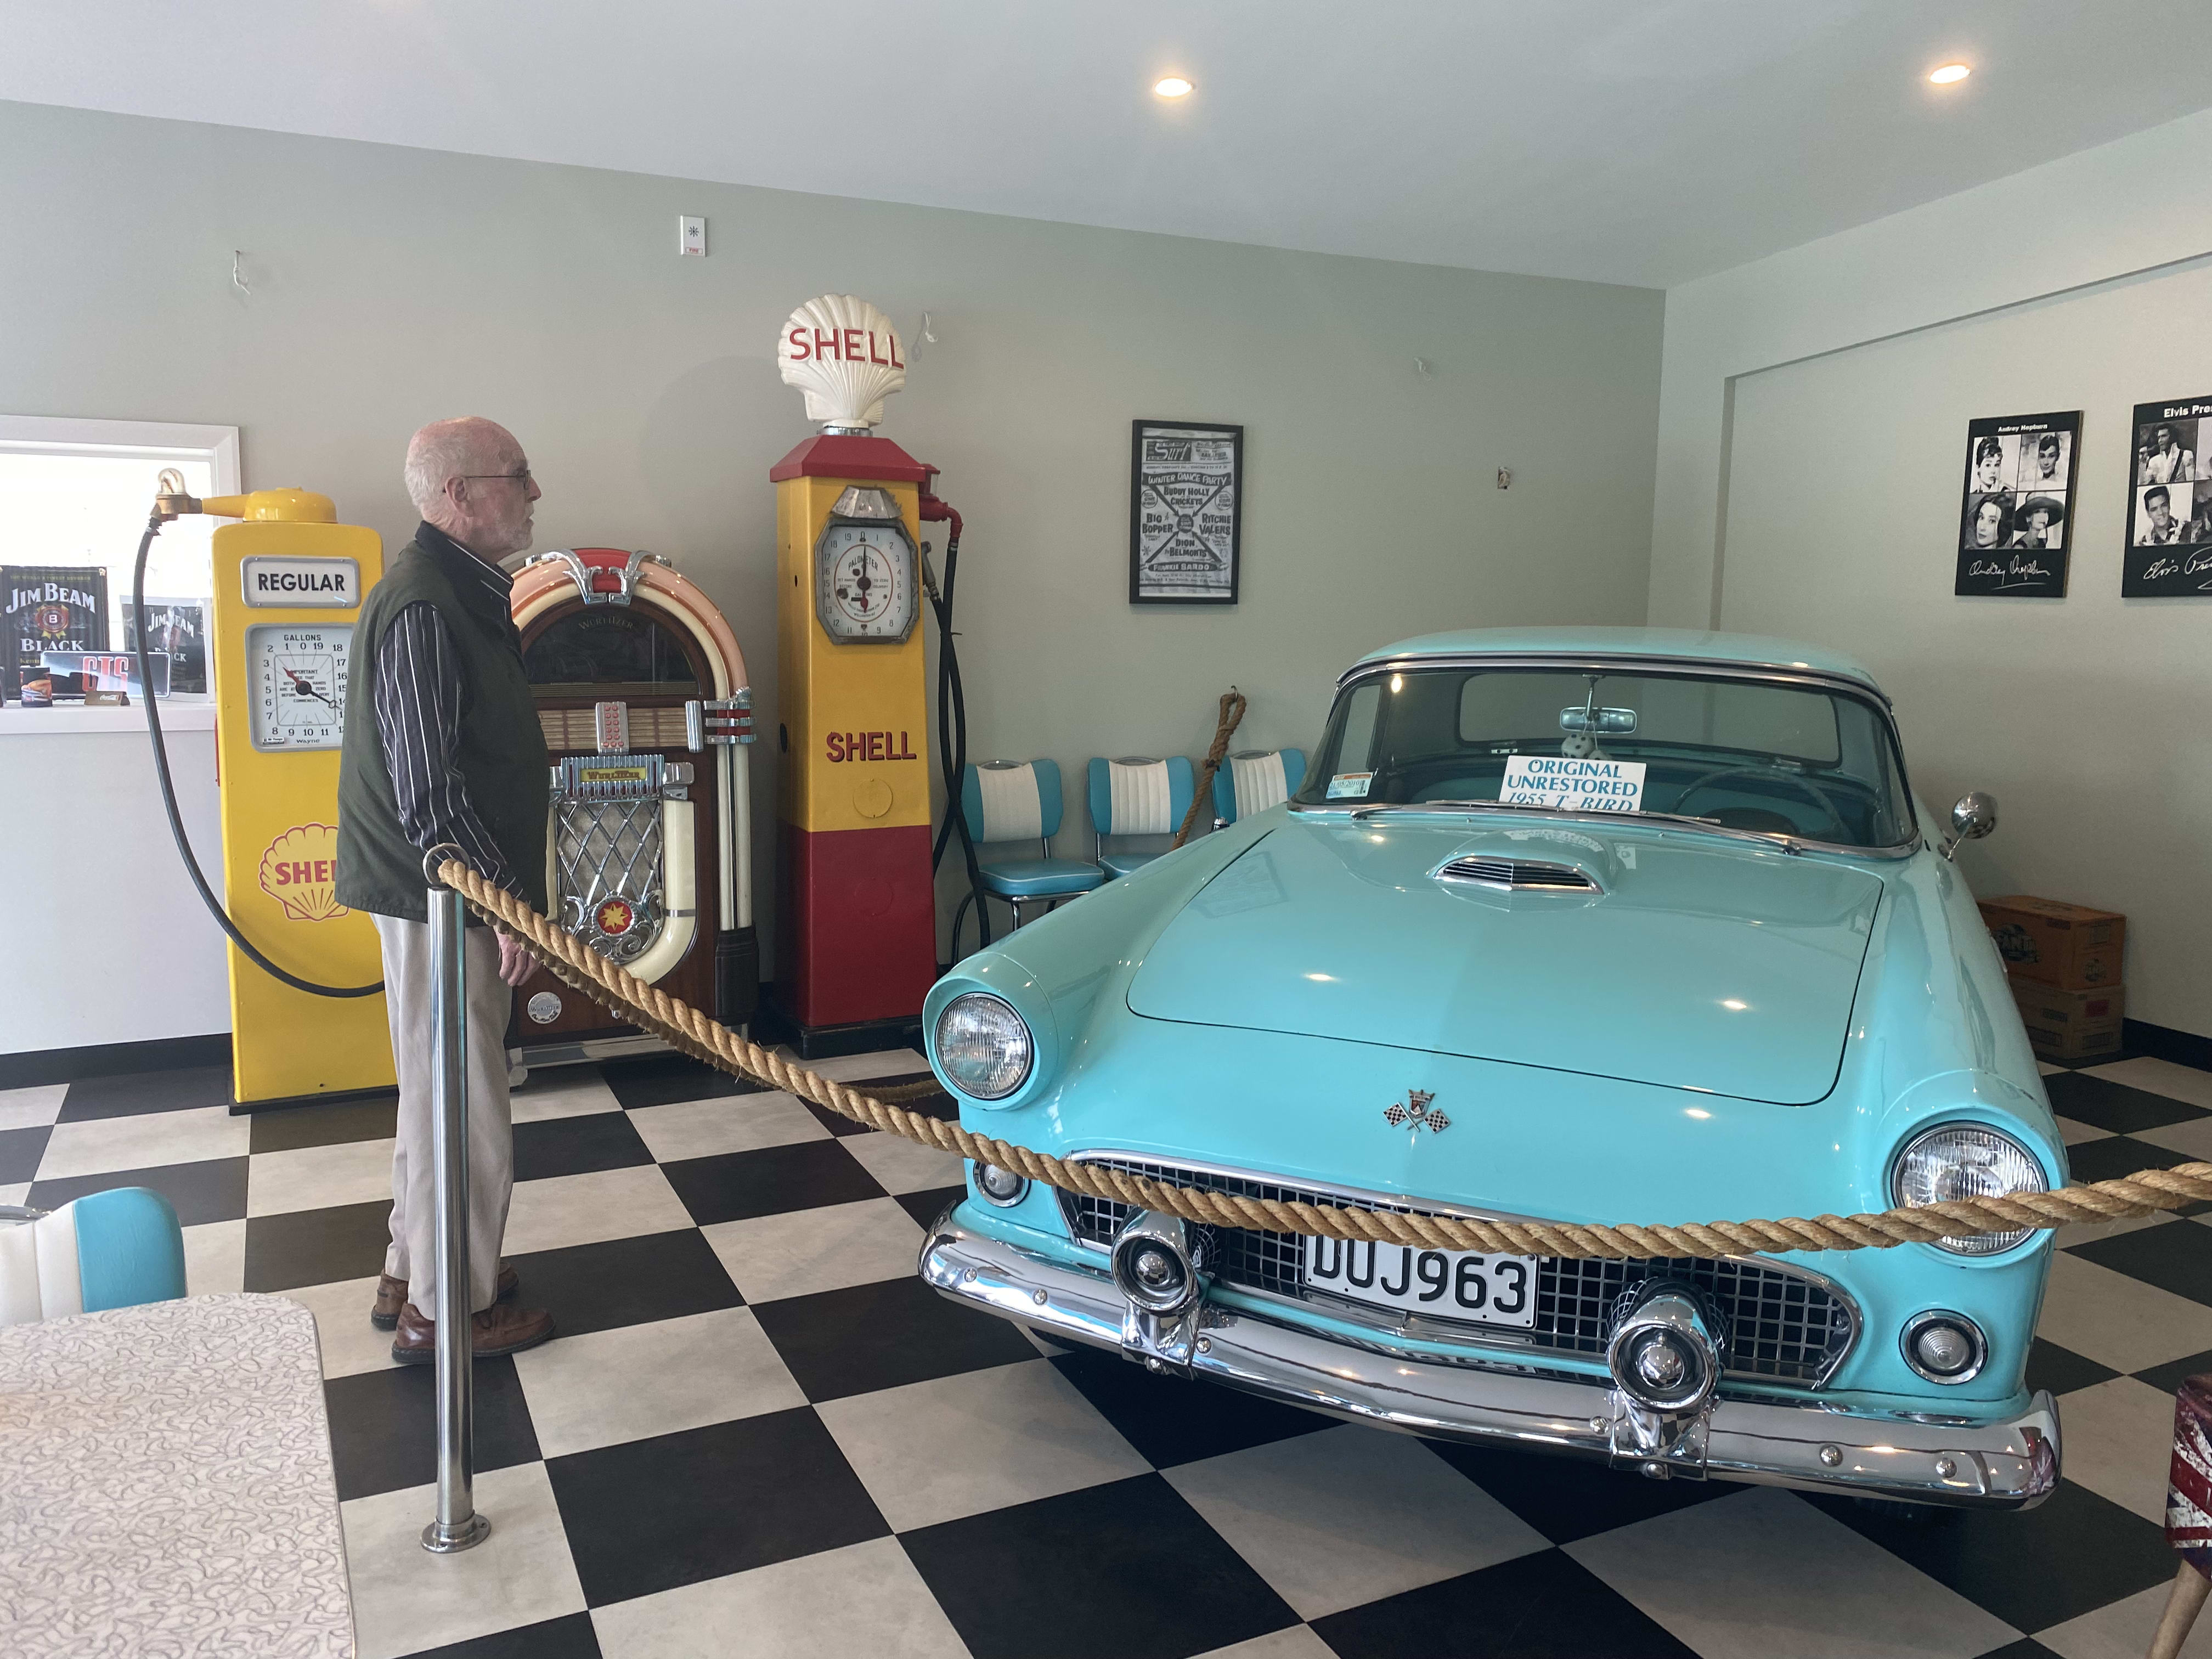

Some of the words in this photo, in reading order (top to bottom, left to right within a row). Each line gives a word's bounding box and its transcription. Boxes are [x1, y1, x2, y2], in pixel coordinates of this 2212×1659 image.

[789, 328, 904, 370] SHELL
[2164, 407, 2189, 418] Elvis
[2191, 404, 2212, 415] Pre
[1148, 475, 1176, 484] WINTER
[1177, 472, 1201, 482] DANCE
[1202, 475, 1227, 486] PARTY
[1163, 486, 1186, 495] BUDDY
[1188, 487, 1210, 496] HOLLY
[1170, 497, 1203, 505] CRICKETS
[1201, 513, 1232, 524] RITCHIE
[1142, 523, 1173, 534] BOPPER
[1199, 524, 1231, 535] VALENS
[844, 533, 851, 541] 19
[830, 540, 838, 549] 18
[1175, 539, 1195, 548] DION
[1169, 547, 1207, 557] BELMONTS
[823, 567, 830, 575] 16
[257, 573, 346, 592] REGULAR
[5, 588, 42, 614] JIM
[44, 583, 96, 614] BEAM
[825, 606, 832, 614] 13
[49, 614, 58, 623] B
[833, 619, 839, 627] 12
[889, 619, 894, 627] 8
[148, 613, 167, 633] JIM
[170, 614, 194, 639] EAM
[20, 638, 84, 652] BLACK
[267, 645, 274, 653] 2
[300, 642, 307, 650] 0
[313, 642, 324, 650] 19
[263, 659, 269, 667] 3
[336, 658, 347, 667] 17
[337, 672, 348, 680] 16
[265, 698, 272, 707] 6
[272, 727, 278, 735] 8
[288, 728, 295, 736] 9
[303, 728, 314, 736] 10
[826, 731, 917, 762] SHELL
[1527, 759, 1622, 778] ORIGINAL
[1508, 774, 1638, 797] UNRESTORED
[1508, 792, 1547, 805] 1955
[274, 860, 337, 885] SHE
[1313, 1234, 1527, 1313] DUJ963
